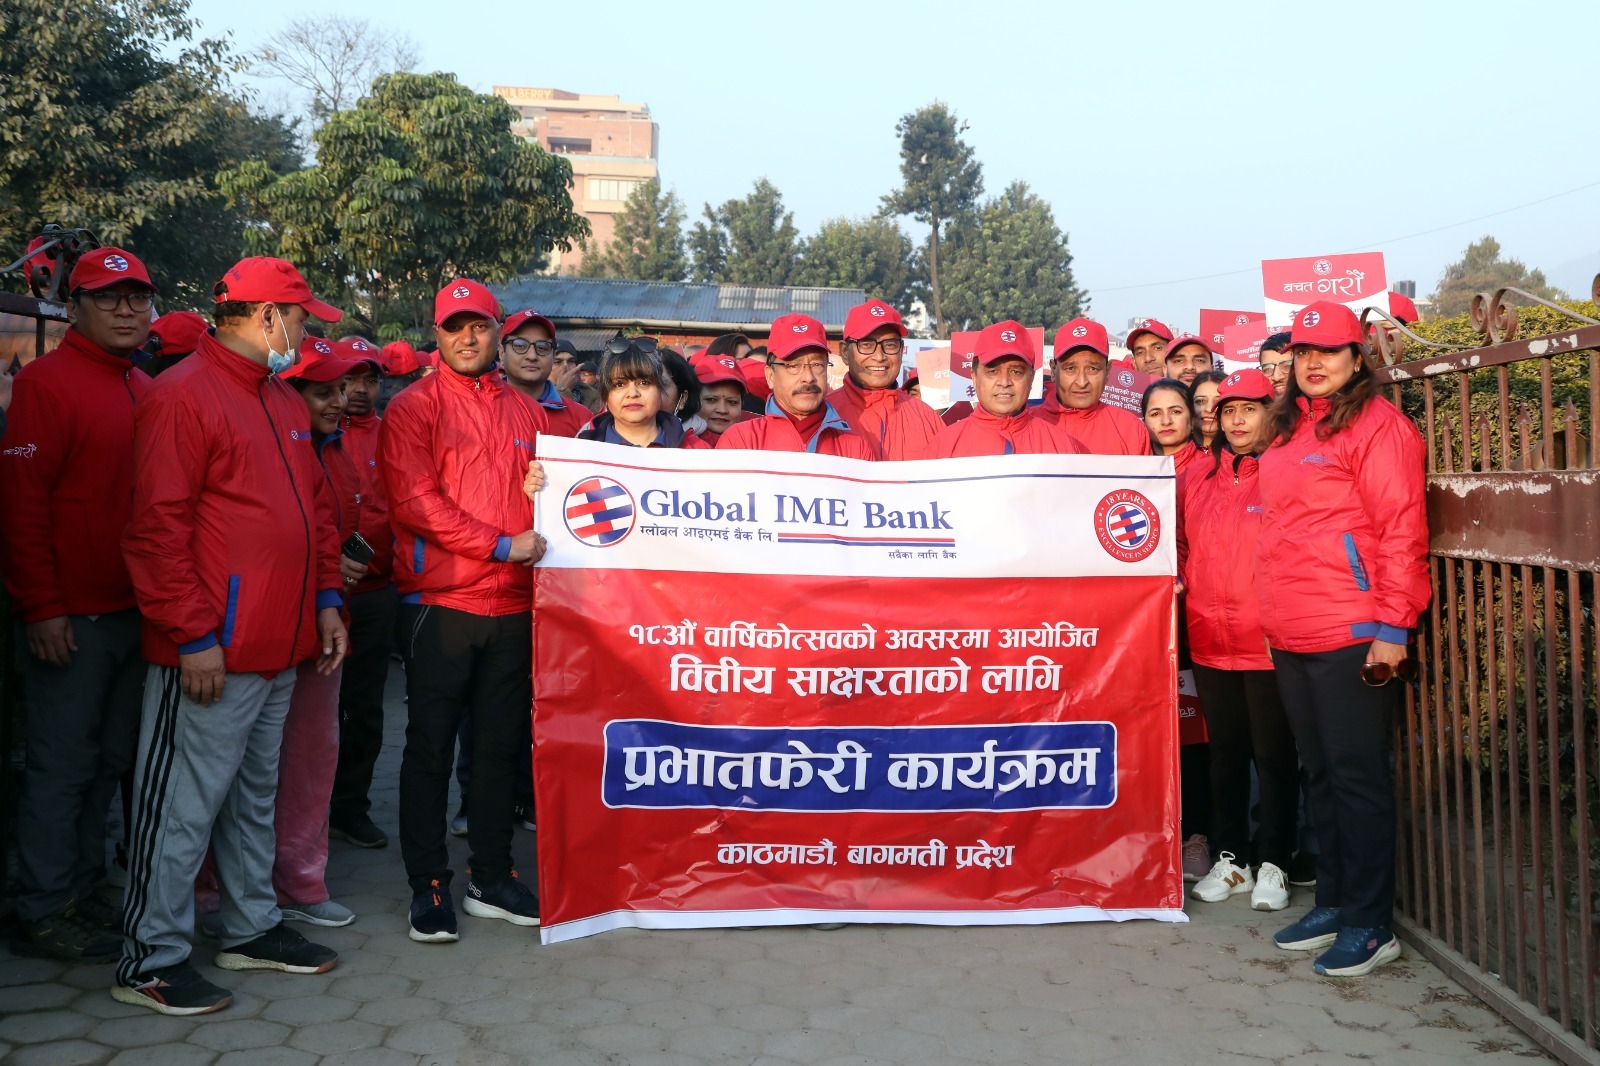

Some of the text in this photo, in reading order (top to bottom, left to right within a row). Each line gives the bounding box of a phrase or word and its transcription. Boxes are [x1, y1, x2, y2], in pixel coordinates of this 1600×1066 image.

[1283, 281, 1315, 293] बचत
[640, 489, 954, 530] Global IME Bank
[1105, 492, 1146, 507] 18 YEARS
[640, 523, 679, 537] ग्लोबल
[682, 526, 730, 541] आइएमई
[733, 526, 753, 541] बैंक
[1098, 527, 1159, 559] EXCELLENCE IN SERVICE
[888, 549, 913, 559] सबैका
[917, 549, 938, 559] लागि
[704, 620, 878, 651] वार्षिकोत्सवको
[885, 629, 991, 650] अवसरमा
[998, 621, 1099, 648] आयोजित
[669, 653, 1063, 698] वित्तीय साक्षरताको लागि
[622, 739, 1101, 793] प्रभातफेरी कार्यक्रम
[847, 838, 948, 866] बागमती
[955, 839, 1016, 869] प्रदेश
